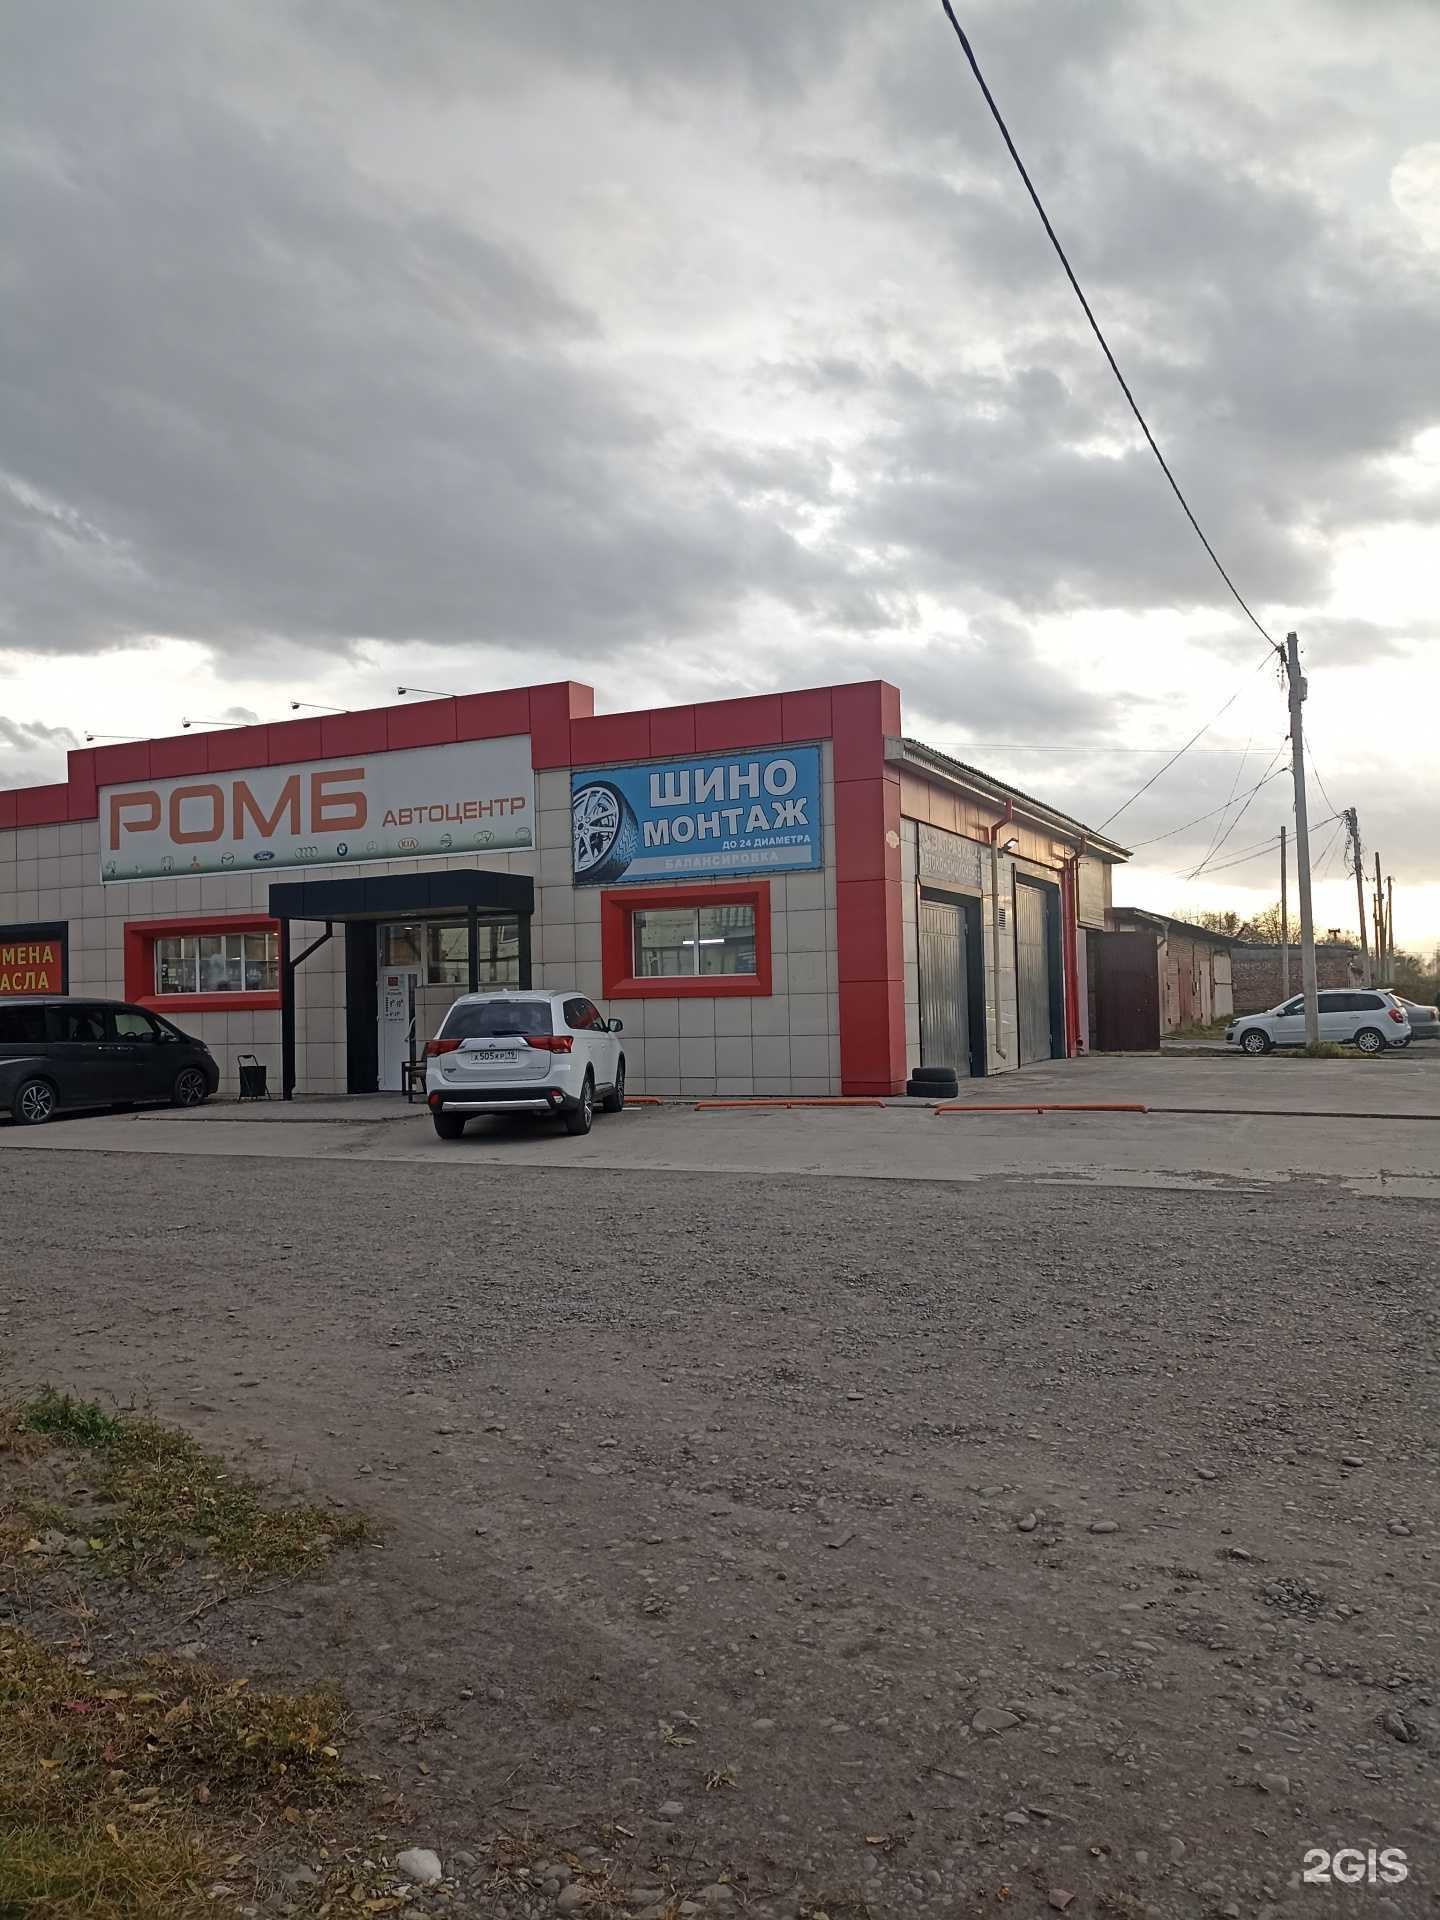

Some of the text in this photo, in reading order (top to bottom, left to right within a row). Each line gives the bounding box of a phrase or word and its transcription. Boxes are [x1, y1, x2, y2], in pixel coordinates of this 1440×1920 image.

[649, 759, 798, 808] ШИНО
[109, 767, 368, 850] РОМБ
[382, 796, 526, 827] АВТОЦЕНТР
[643, 797, 809, 848] МОНТАЖ
[664, 851, 779, 870] БАЛАНСИРОВКА
[722, 834, 811, 850] ДО 24 ДИАМЕТРА
